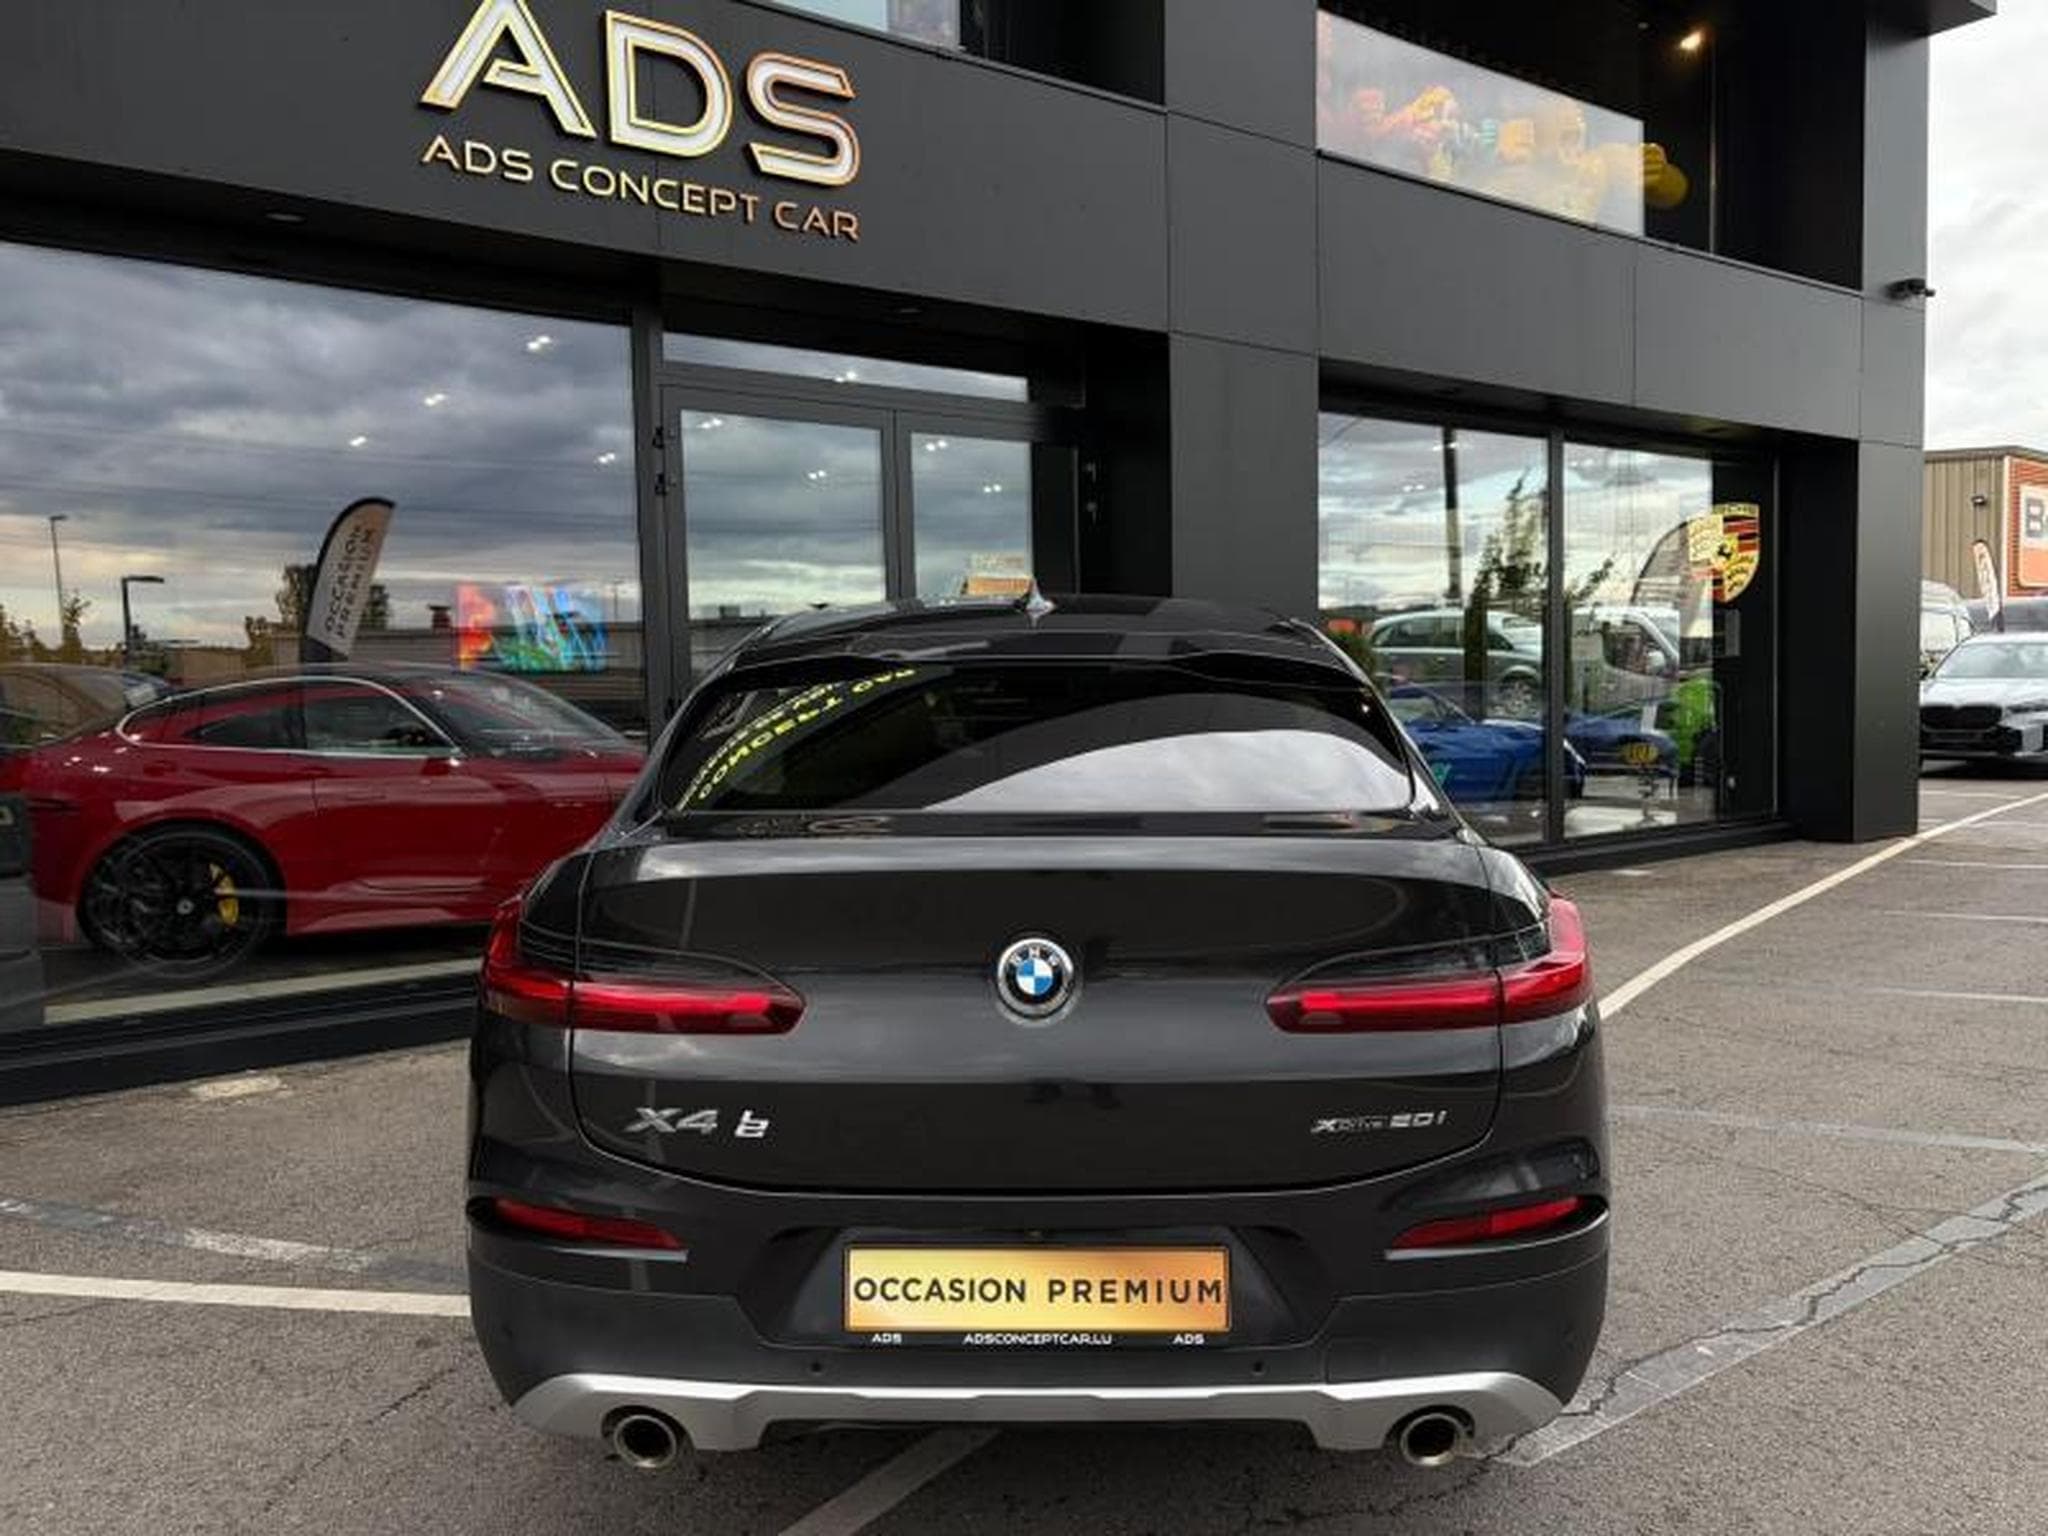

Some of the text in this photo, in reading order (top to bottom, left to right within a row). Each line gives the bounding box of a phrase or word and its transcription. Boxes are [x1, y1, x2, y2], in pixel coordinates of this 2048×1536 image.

[418, 0, 862, 187] ADS
[421, 134, 861, 242] ADS CONCEPT CAR
[2026, 497, 2048, 538] B
[624, 1107, 718, 1134] X4
[853, 1277, 1222, 1304] OCCASION PREMIUM
[871, 1333, 1204, 1345] ADS ADSCONCEPTCAR.LU ADS
